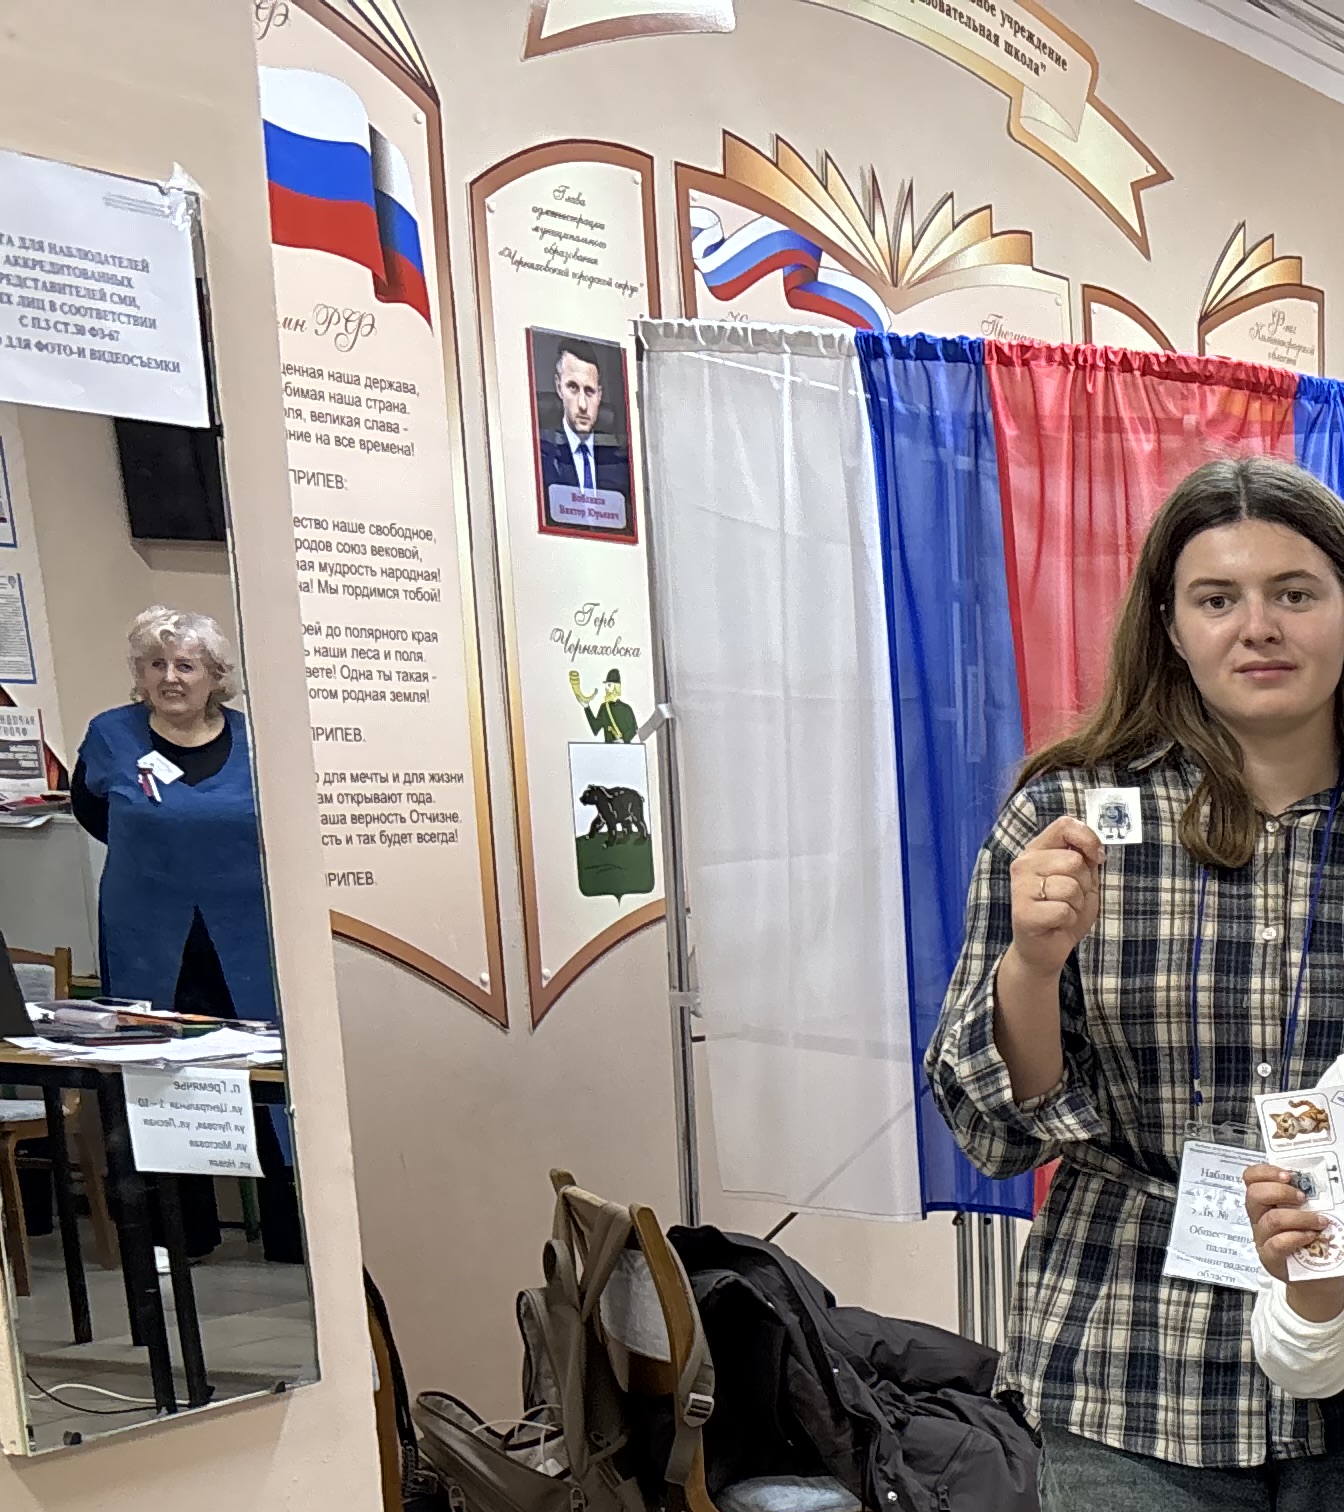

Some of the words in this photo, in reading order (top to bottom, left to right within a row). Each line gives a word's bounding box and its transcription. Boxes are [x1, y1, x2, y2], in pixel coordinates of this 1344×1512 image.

[1000, 9, 1068, 72] учреждение
[553, 185, 586, 207] Глава
[18, 236, 45, 253] ДЛЯ
[48, 242, 150, 273] НАБЛЮДАТЕЛЕЙ
[3, 255, 134, 288] АККРЕДИТОВАННЫХ
[17, 295, 45, 313] ЛИЦ
[50, 300, 57, 312] В
[59, 302, 157, 330] СООТВЕТСТВИИ
[18, 315, 28, 328] С
[6, 335, 31, 350] ДЛЯ
[283, 382, 324, 401] бимая
[328, 391, 362, 407] наша
[328, 370, 360, 386] наша
[364, 376, 420, 398] держава,
[310, 410, 360, 428] великая
[365, 418, 400, 434] слава
[286, 429, 311, 443] ние
[316, 432, 330, 446] на
[335, 435, 355, 449] все
[360, 439, 415, 457] времена!
[293, 516, 328, 531] ество
[333, 519, 365, 535] наше
[369, 523, 437, 543] свободное,
[336, 542, 367, 556] союз
[371, 545, 422, 562] вековой,
[319, 560, 377, 580] мудрость
[380, 567, 441, 583] народная!
[318, 579, 338, 594] Мы
[342, 584, 399, 600] гордимся
[404, 587, 441, 603] тобой!
[574, 602, 618, 635] Герб
[326, 625, 341, 639] до
[345, 626, 408, 643] полярного
[412, 631, 438, 644] края
[550, 628, 641, 662] Черняховска
[314, 646, 347, 659] наши
[351, 647, 380, 660] леса
[384, 650, 391, 661] и
[340, 665, 373, 681] Одна
[377, 669, 392, 682] ты
[397, 669, 429, 683] такая
[309, 687, 338, 700] огом
[342, 687, 386, 704] родная
[390, 688, 430, 703] земля!
[323, 772, 346, 786] для
[350, 772, 388, 784] мечты
[393, 772, 399, 784] и
[403, 772, 425, 786] для
[428, 772, 464, 784] жизни
[337, 791, 402, 807] открывают
[351, 812, 406, 827] верность
[346, 833, 353, 845] и
[357, 831, 376, 845] так
[380, 830, 412, 848] будет
[417, 828, 459, 844] всегда!
